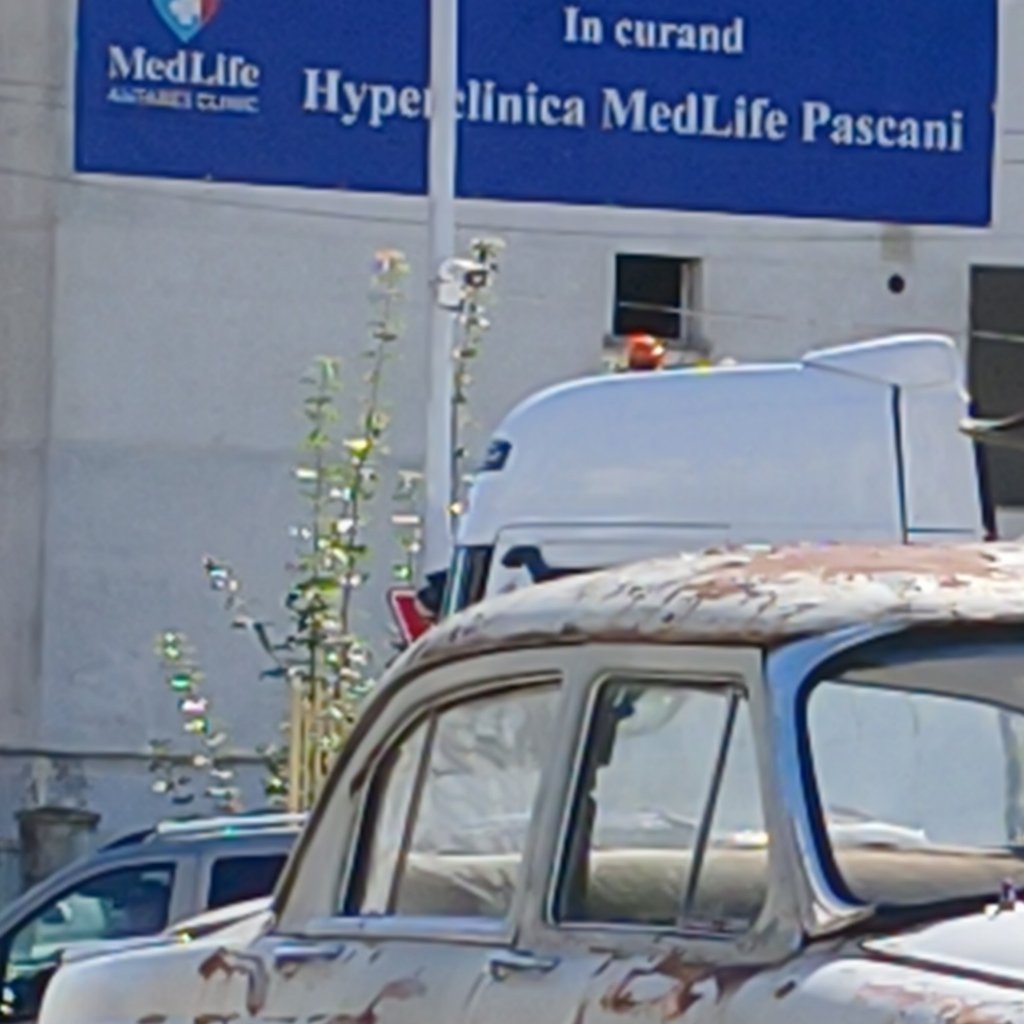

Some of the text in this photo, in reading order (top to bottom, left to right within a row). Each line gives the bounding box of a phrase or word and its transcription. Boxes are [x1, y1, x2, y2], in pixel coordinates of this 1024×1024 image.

[564, 6, 744, 54] In curand
[107, 44, 261, 88] MedLife
[602, 87, 788, 140] MedLife
[801, 101, 964, 152] Pascani
